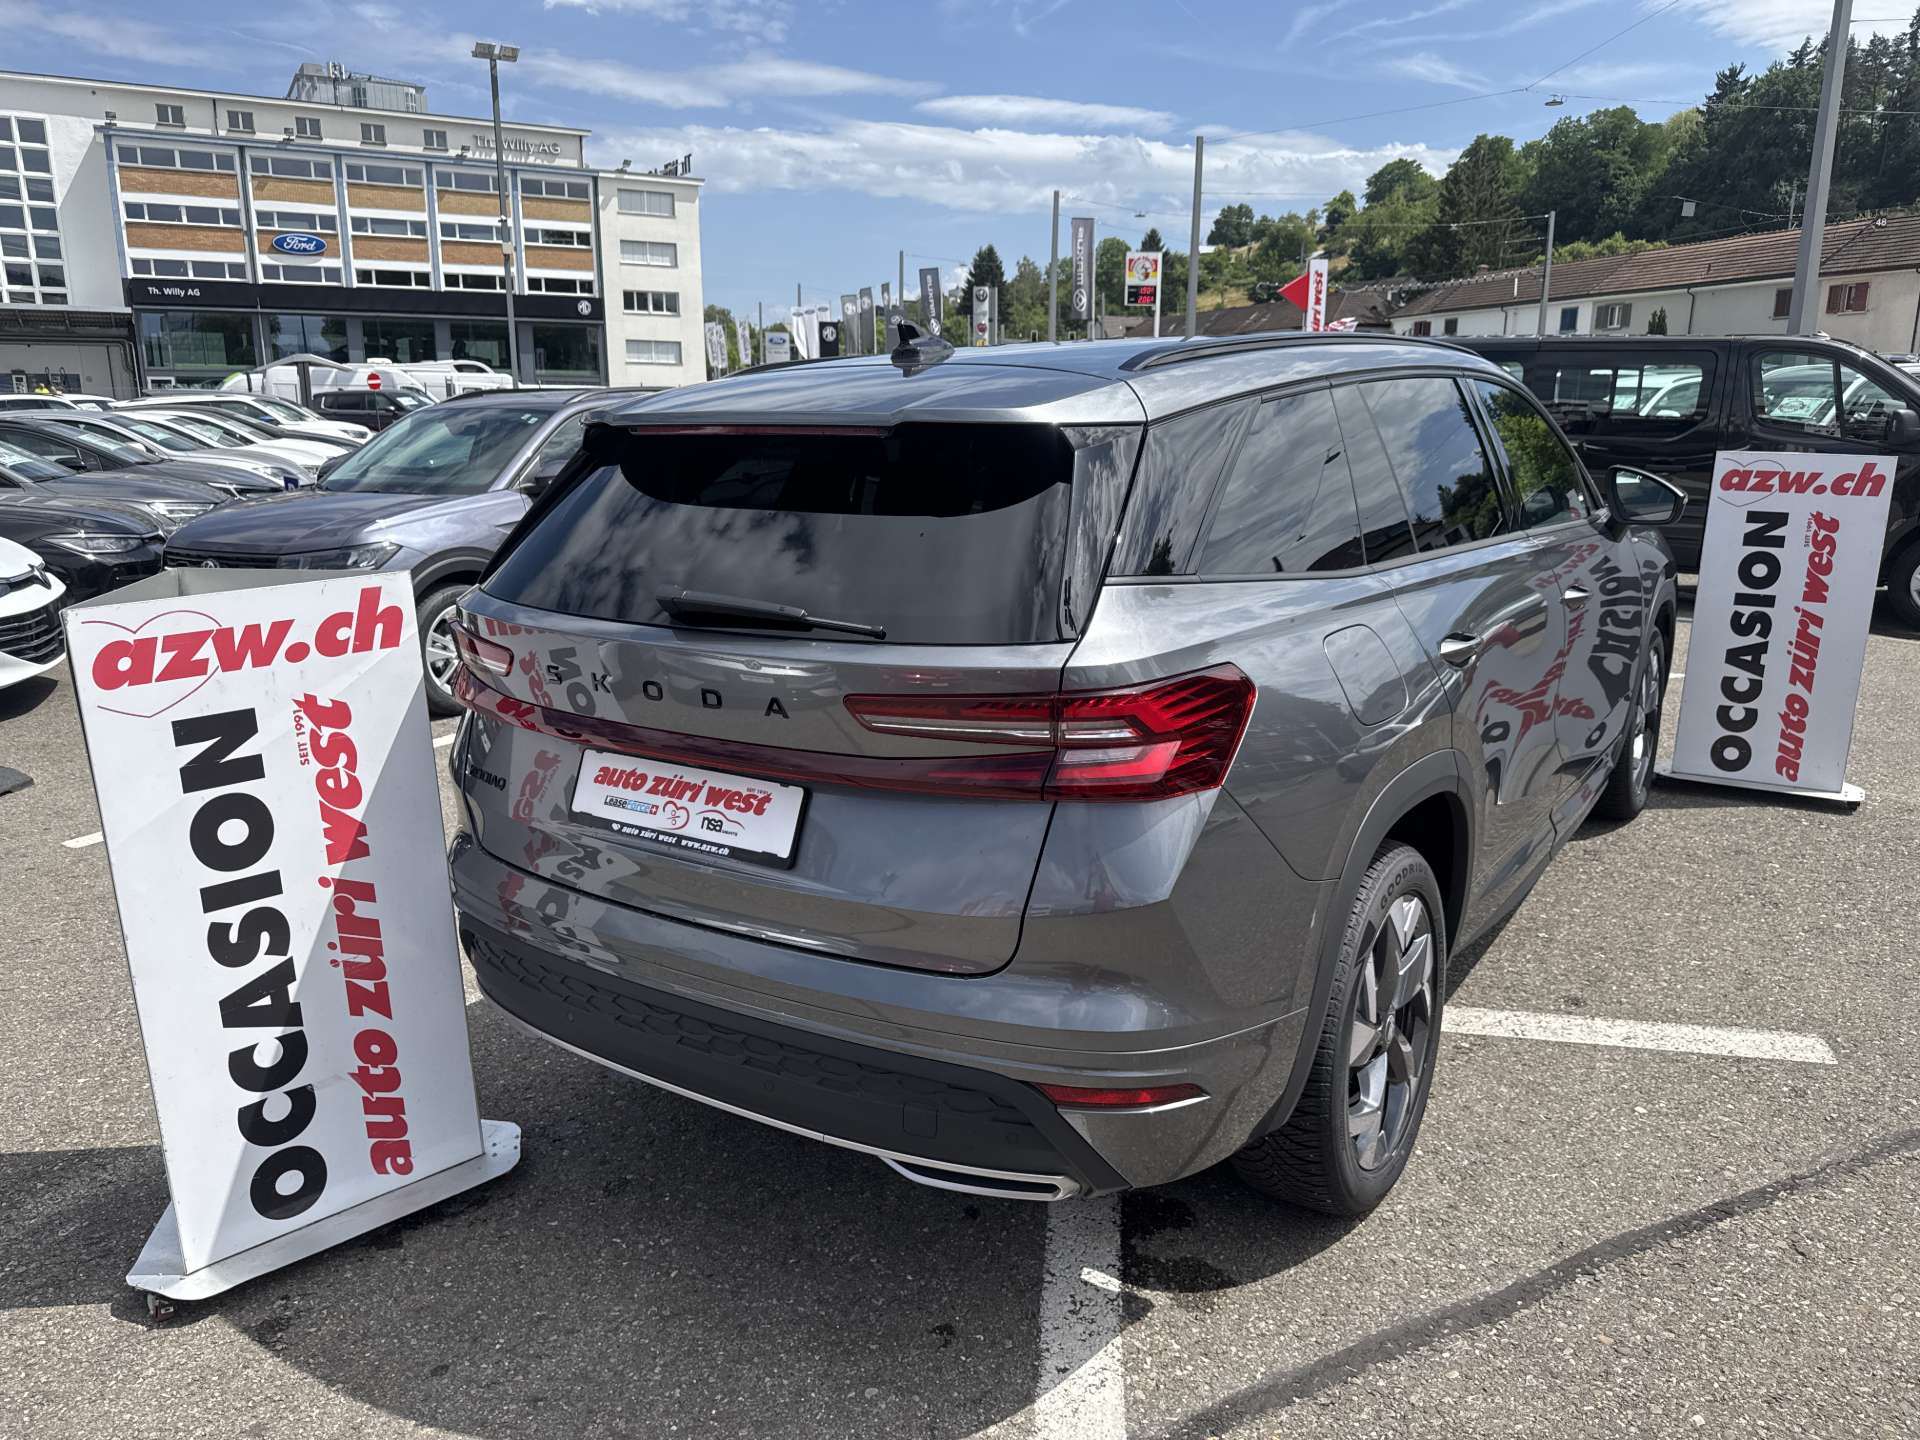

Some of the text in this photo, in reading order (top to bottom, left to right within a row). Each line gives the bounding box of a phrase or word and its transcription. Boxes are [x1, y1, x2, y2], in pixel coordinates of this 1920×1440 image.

[502, 136, 535, 154] Willy
[539, 142, 561, 154] AG
[1876, 218, 1887, 226] 48
[147, 286, 201, 297] Th. Willy AG
[1719, 463, 1887, 498] azw.ch
[91, 585, 405, 692] azw.ch
[1710, 510, 1790, 773] OCCASION
[1774, 511, 1840, 783] auto züri west
[546, 664, 791, 720] SKODA
[292, 708, 311, 767] SEIT 1991
[593, 766, 774, 817] auto züri west
[621, 825, 730, 856] auto züri west www.azw.ch
[700, 815, 723, 834] nsa
[291, 691, 414, 1177] auto züri west
[171, 707, 329, 1221] OCCASION
